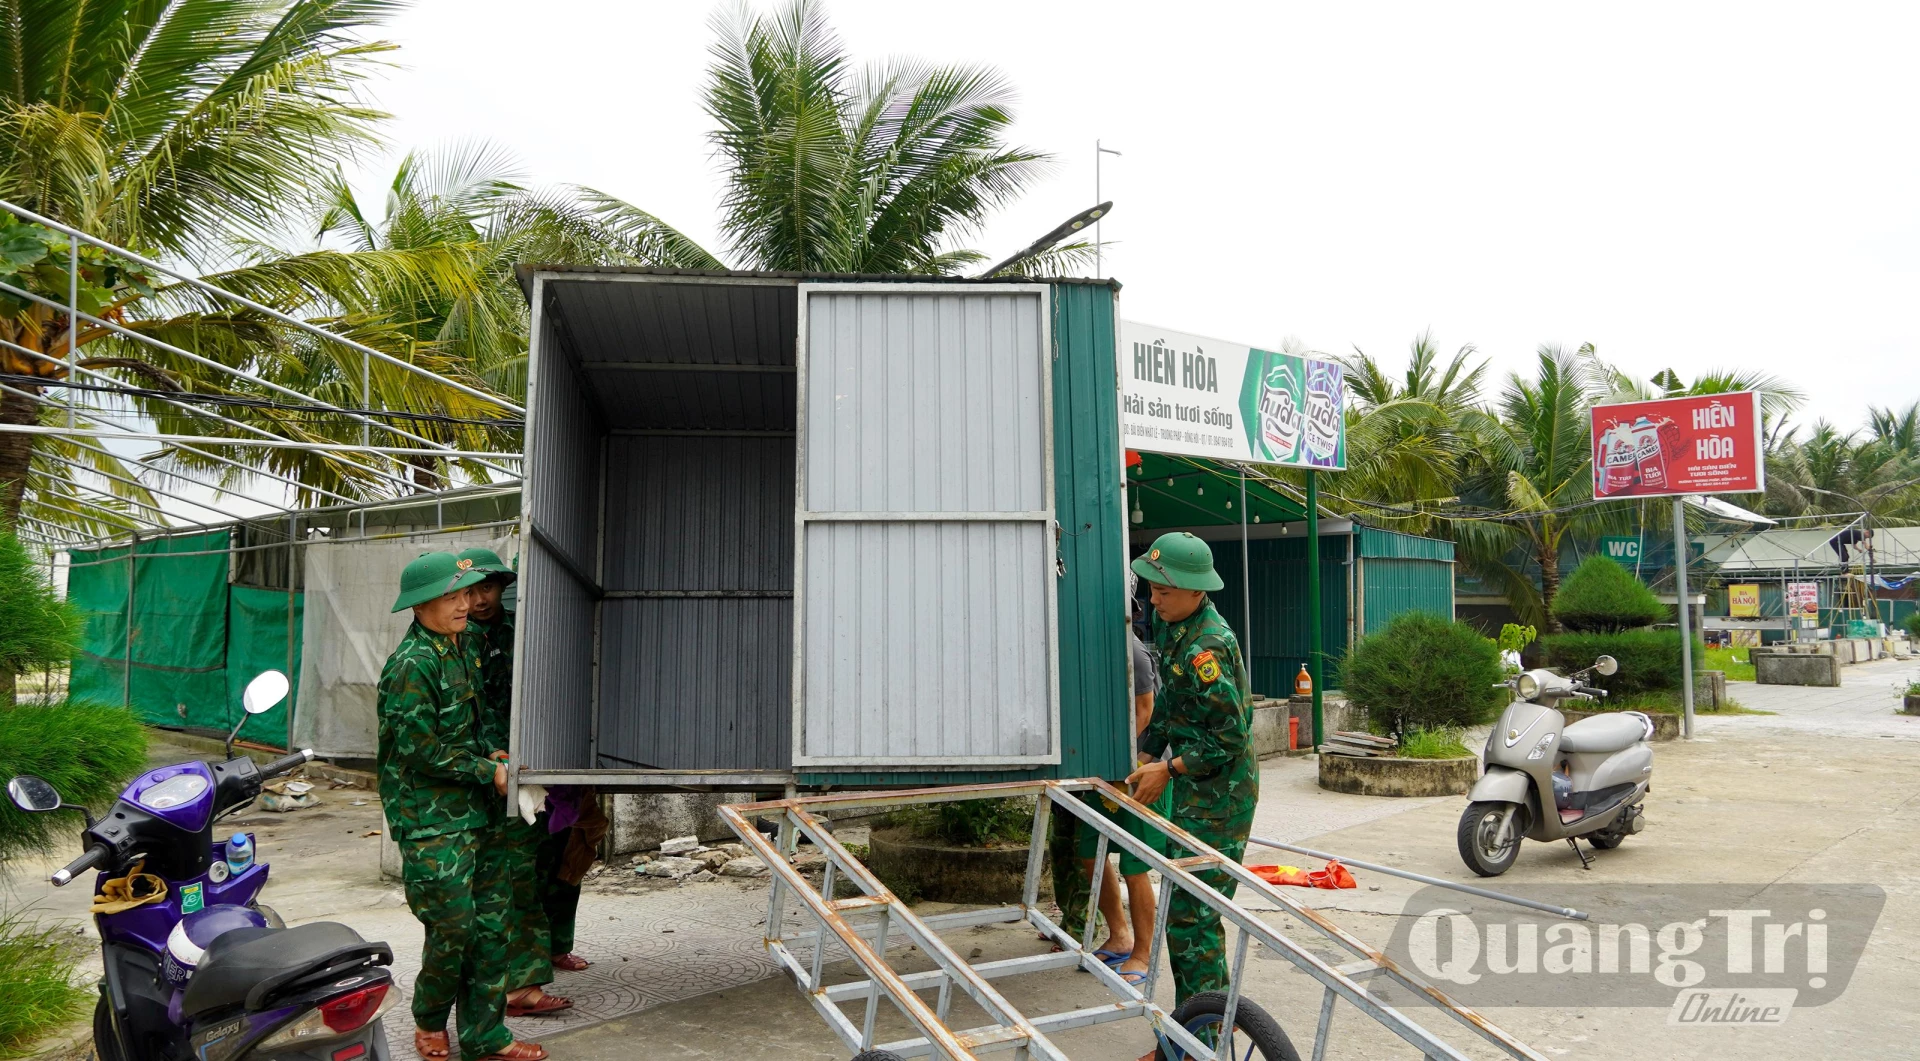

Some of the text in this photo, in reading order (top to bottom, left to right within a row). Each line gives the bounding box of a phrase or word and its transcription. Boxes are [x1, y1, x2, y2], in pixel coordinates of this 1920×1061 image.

[1134, 338, 1218, 393] HIỀN HÒA
[1124, 393, 1232, 430] Hải sản tươi sống
[1692, 400, 1734, 430] HIỀN
[1316, 436, 1334, 452] TWIST
[1637, 444, 1658, 458] CAMEL
[1696, 434, 1734, 460] HÒA
[1608, 541, 1638, 557] WC
[206, 1021, 239, 1042] Galaxy
